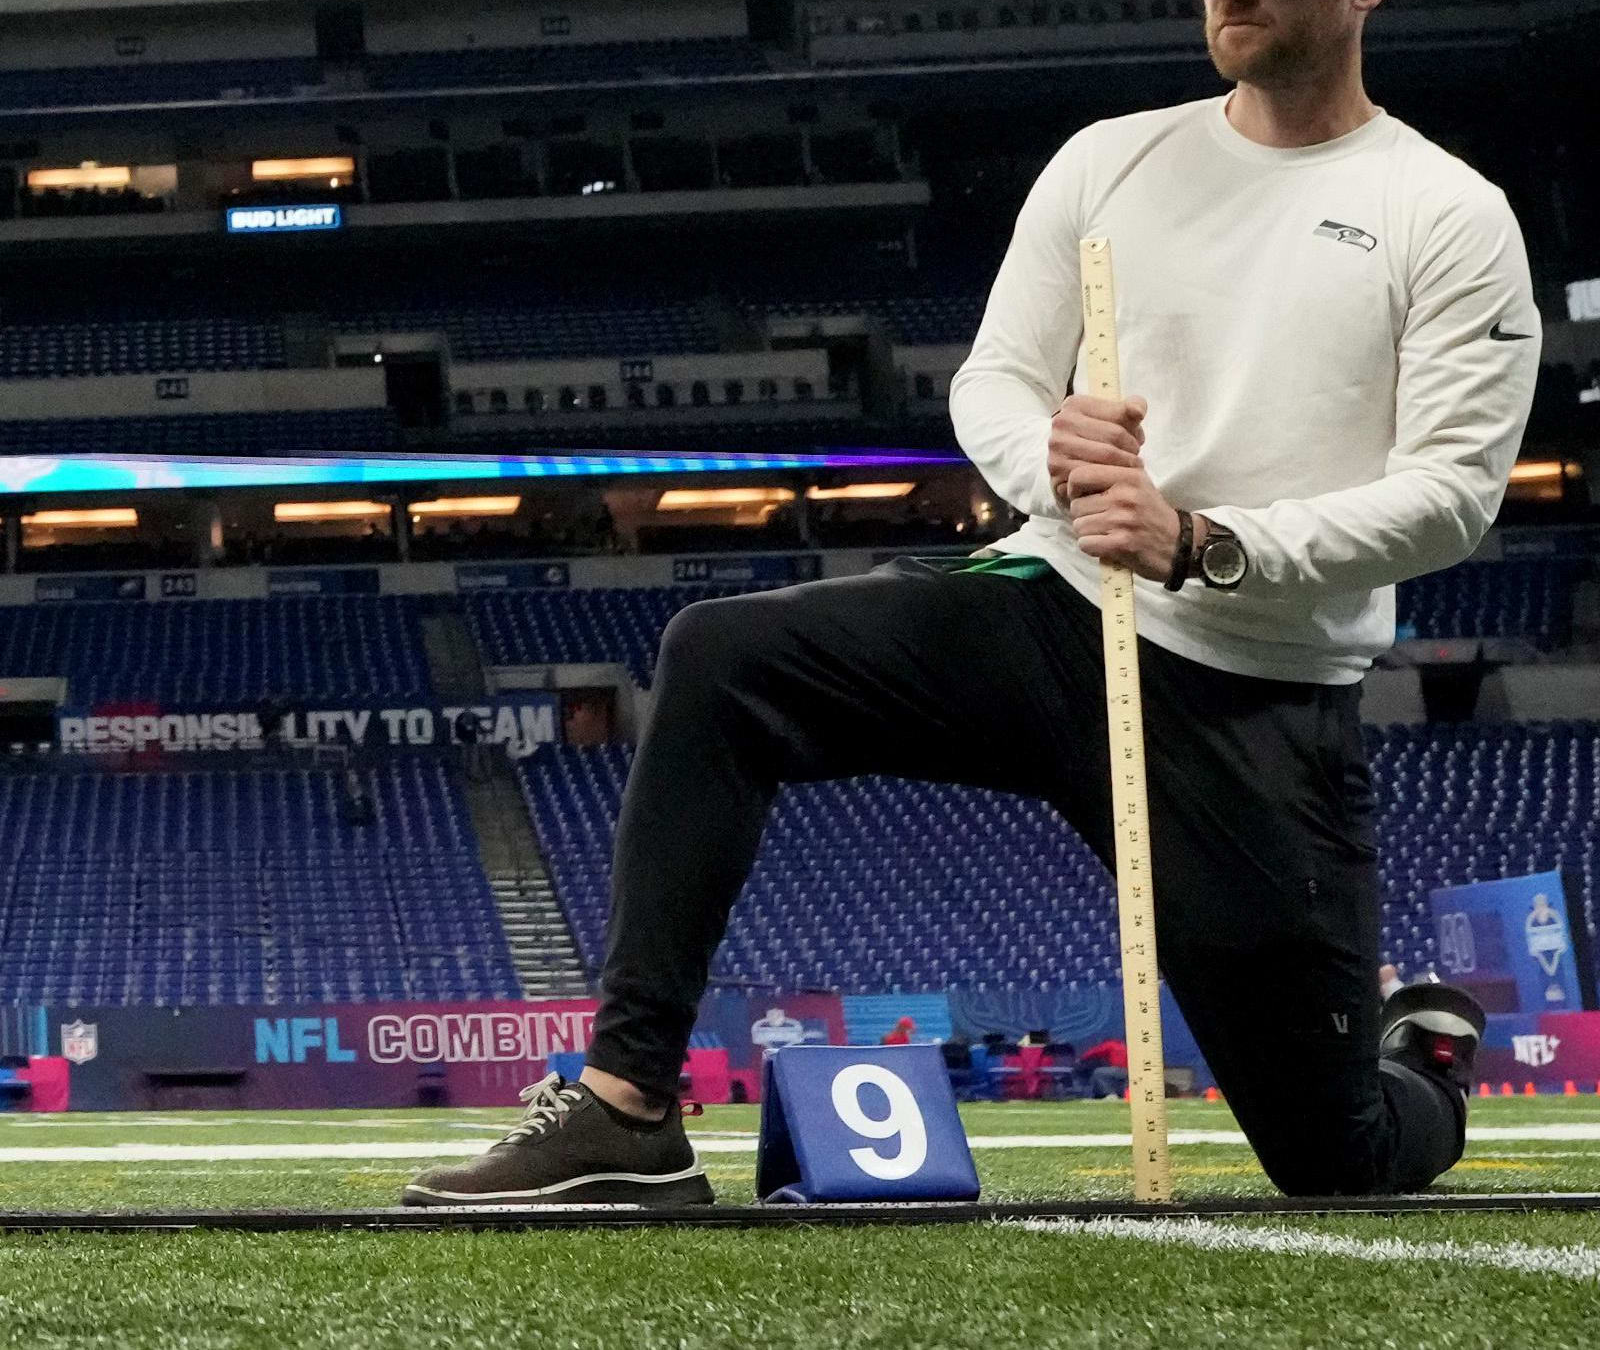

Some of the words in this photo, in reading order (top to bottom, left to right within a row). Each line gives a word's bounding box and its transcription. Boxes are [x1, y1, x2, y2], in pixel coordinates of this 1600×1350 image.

[231, 210, 275, 229] BUD
[275, 208, 335, 227] LIGHT
[379, 708, 433, 744] TO
[254, 1018, 356, 1064] NFL
[831, 1063, 928, 1180] 9
